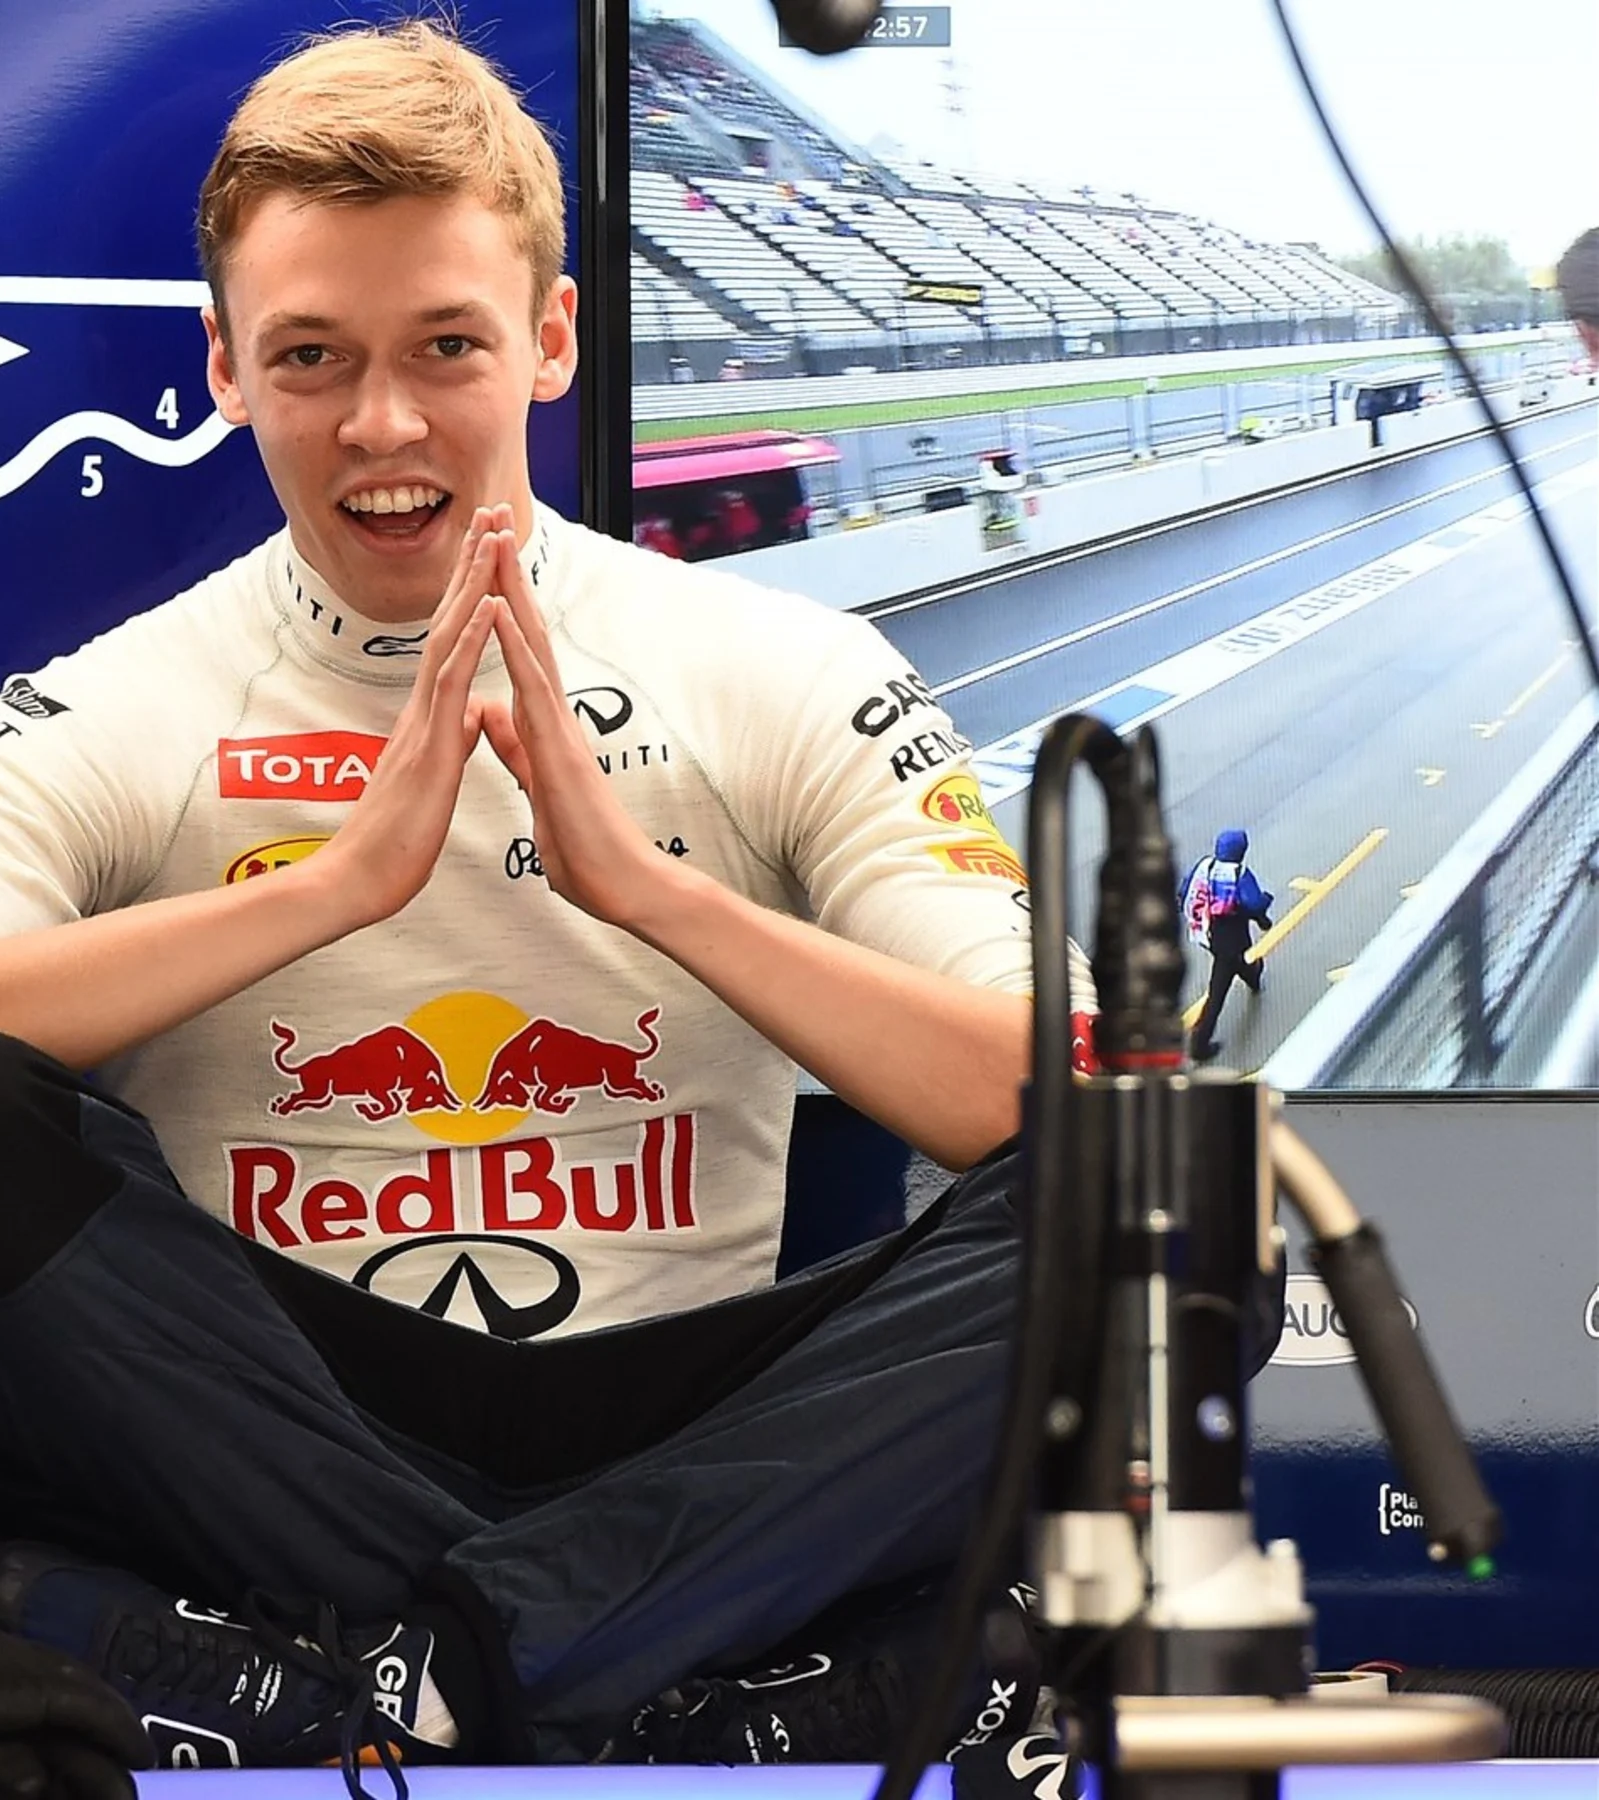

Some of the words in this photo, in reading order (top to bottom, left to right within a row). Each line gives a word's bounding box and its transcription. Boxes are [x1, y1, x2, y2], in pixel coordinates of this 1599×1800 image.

[864, 16, 928, 38] 2:57
[155, 388, 180, 429] 4
[81, 455, 103, 497] 5
[851, 673, 938, 738] CAS
[226, 749, 373, 787] TOTA
[229, 1146, 456, 1248] Red
[478, 1112, 697, 1233] Bull
[1284, 1303, 1350, 1338] AUC
